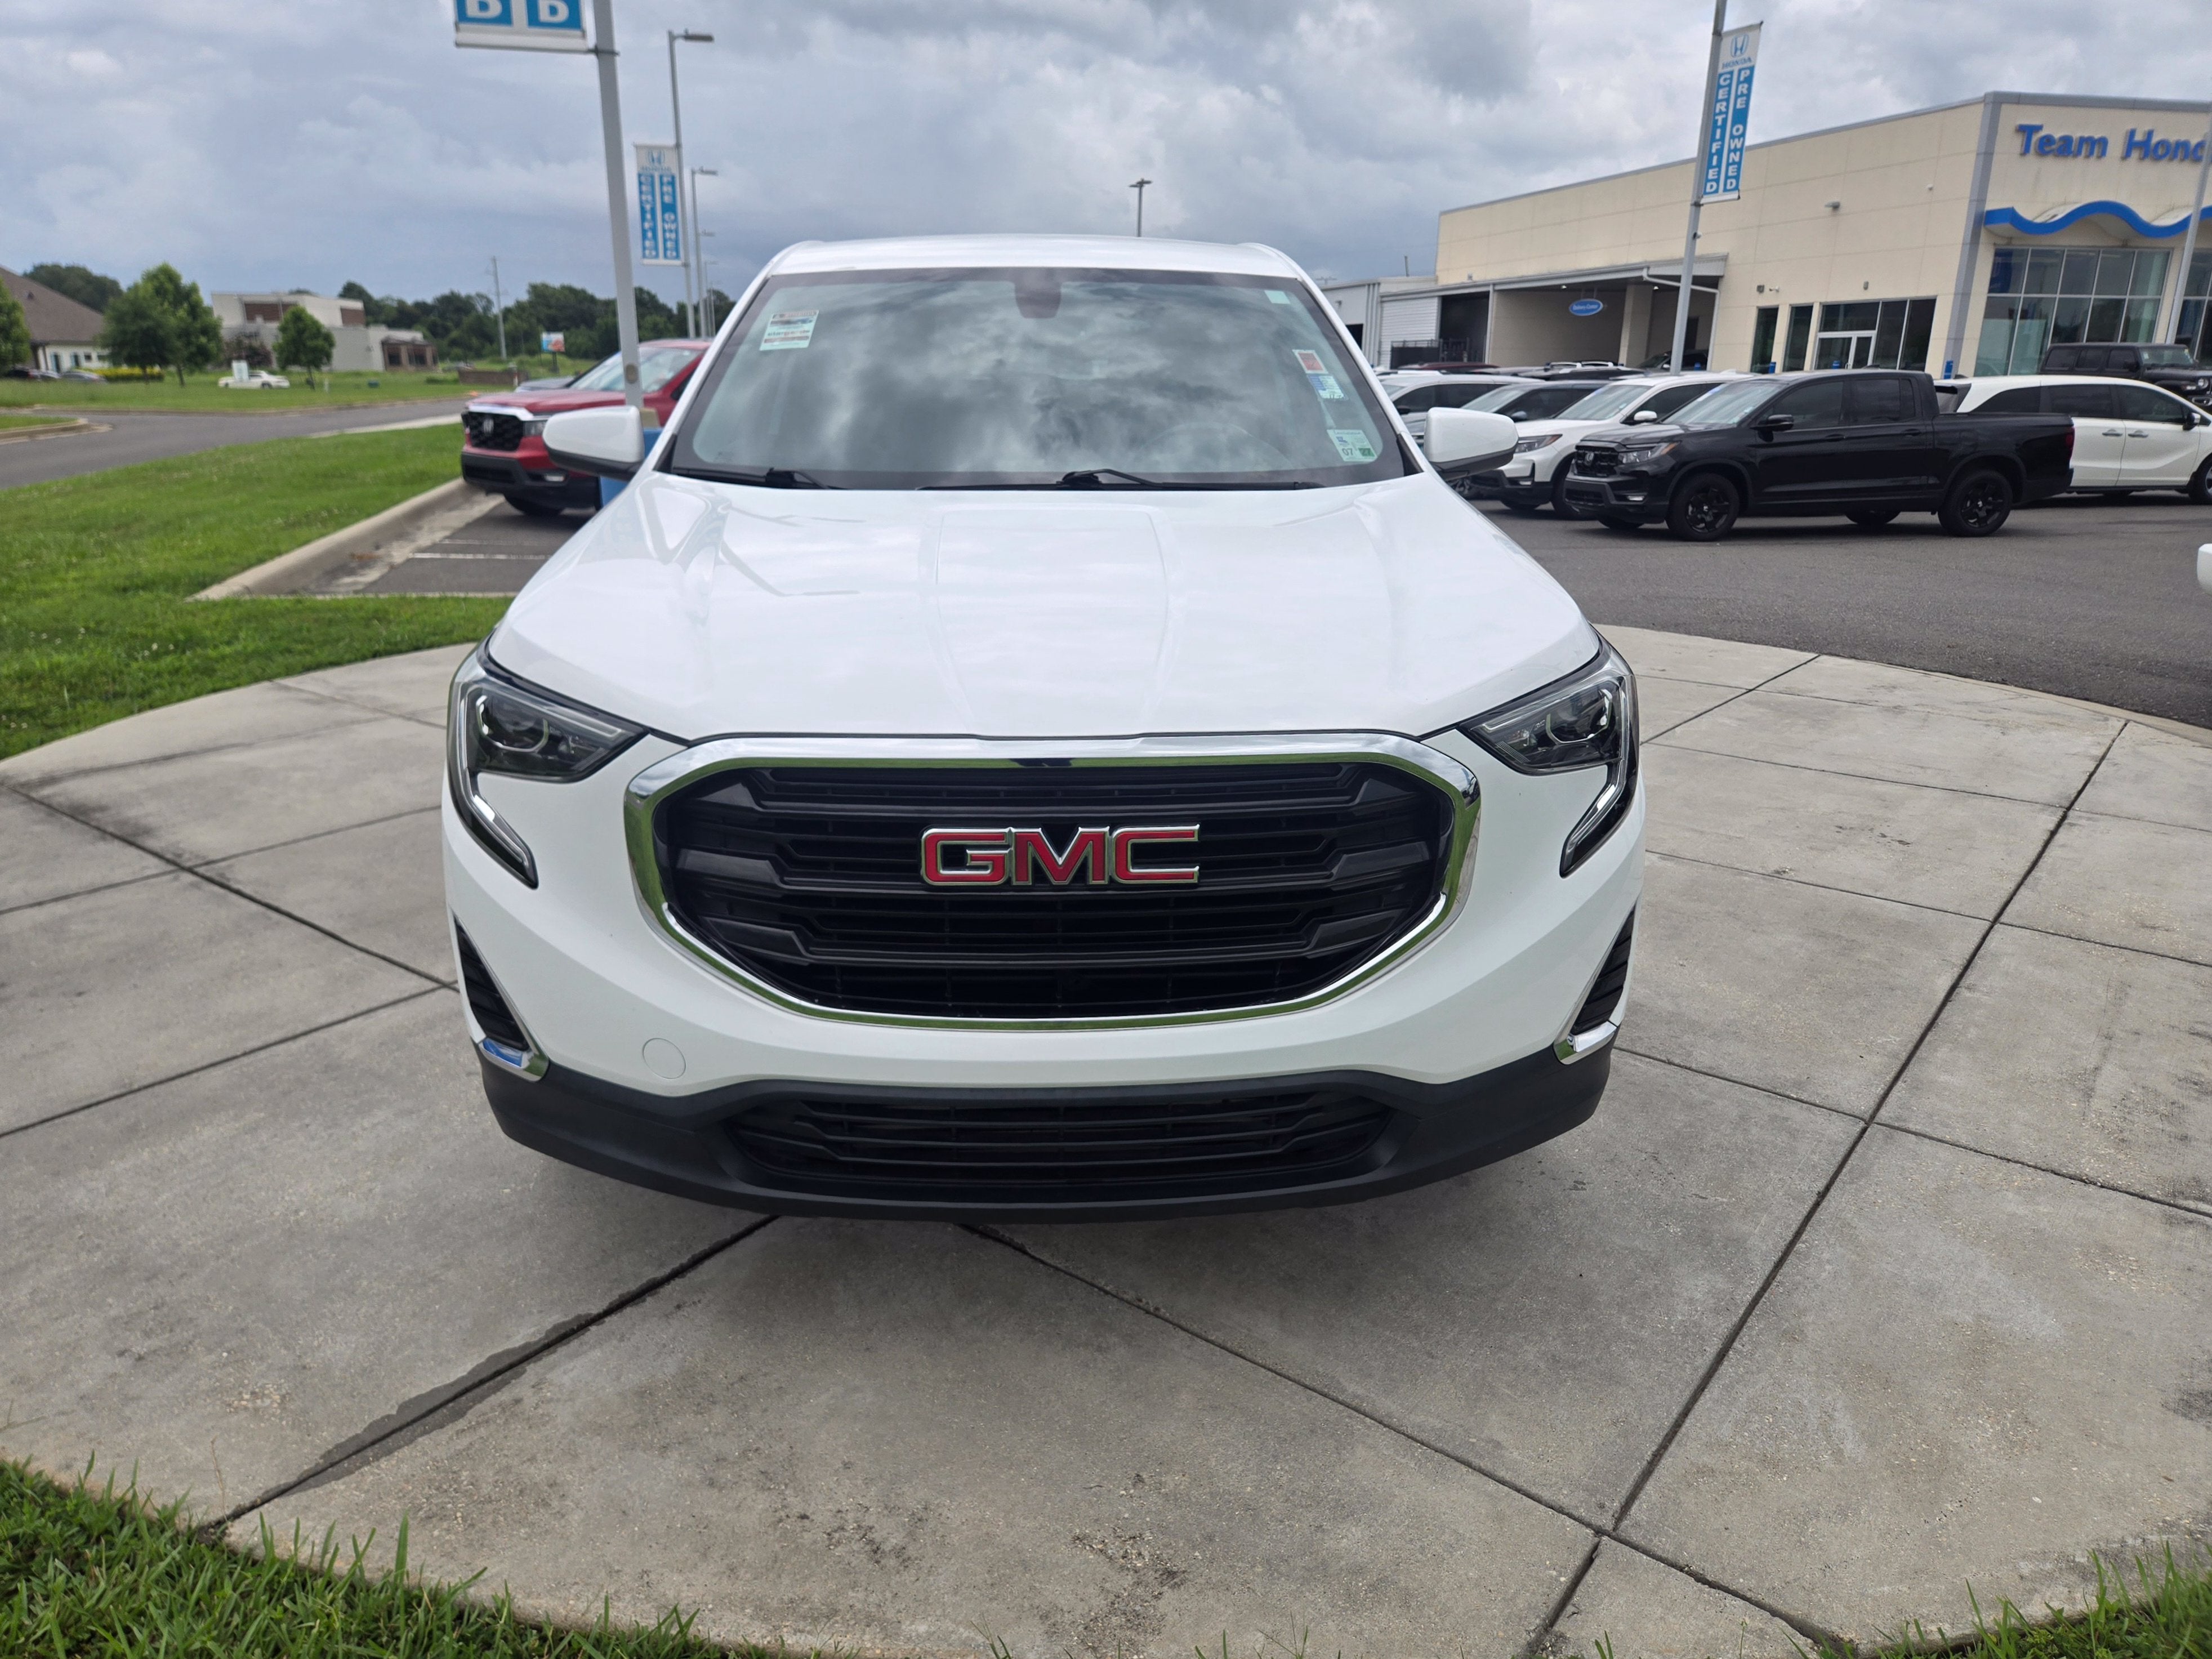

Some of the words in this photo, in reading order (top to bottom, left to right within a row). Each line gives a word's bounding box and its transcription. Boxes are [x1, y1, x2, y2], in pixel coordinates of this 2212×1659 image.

[1722, 57, 1752, 69] HONDA
[1736, 69, 1750, 110] PRE
[1705, 74, 1731, 193] CERTIFIED
[1726, 124, 1743, 190] OWNED
[2015, 124, 2108, 158] Team
[920, 824, 1201, 886] GMC
